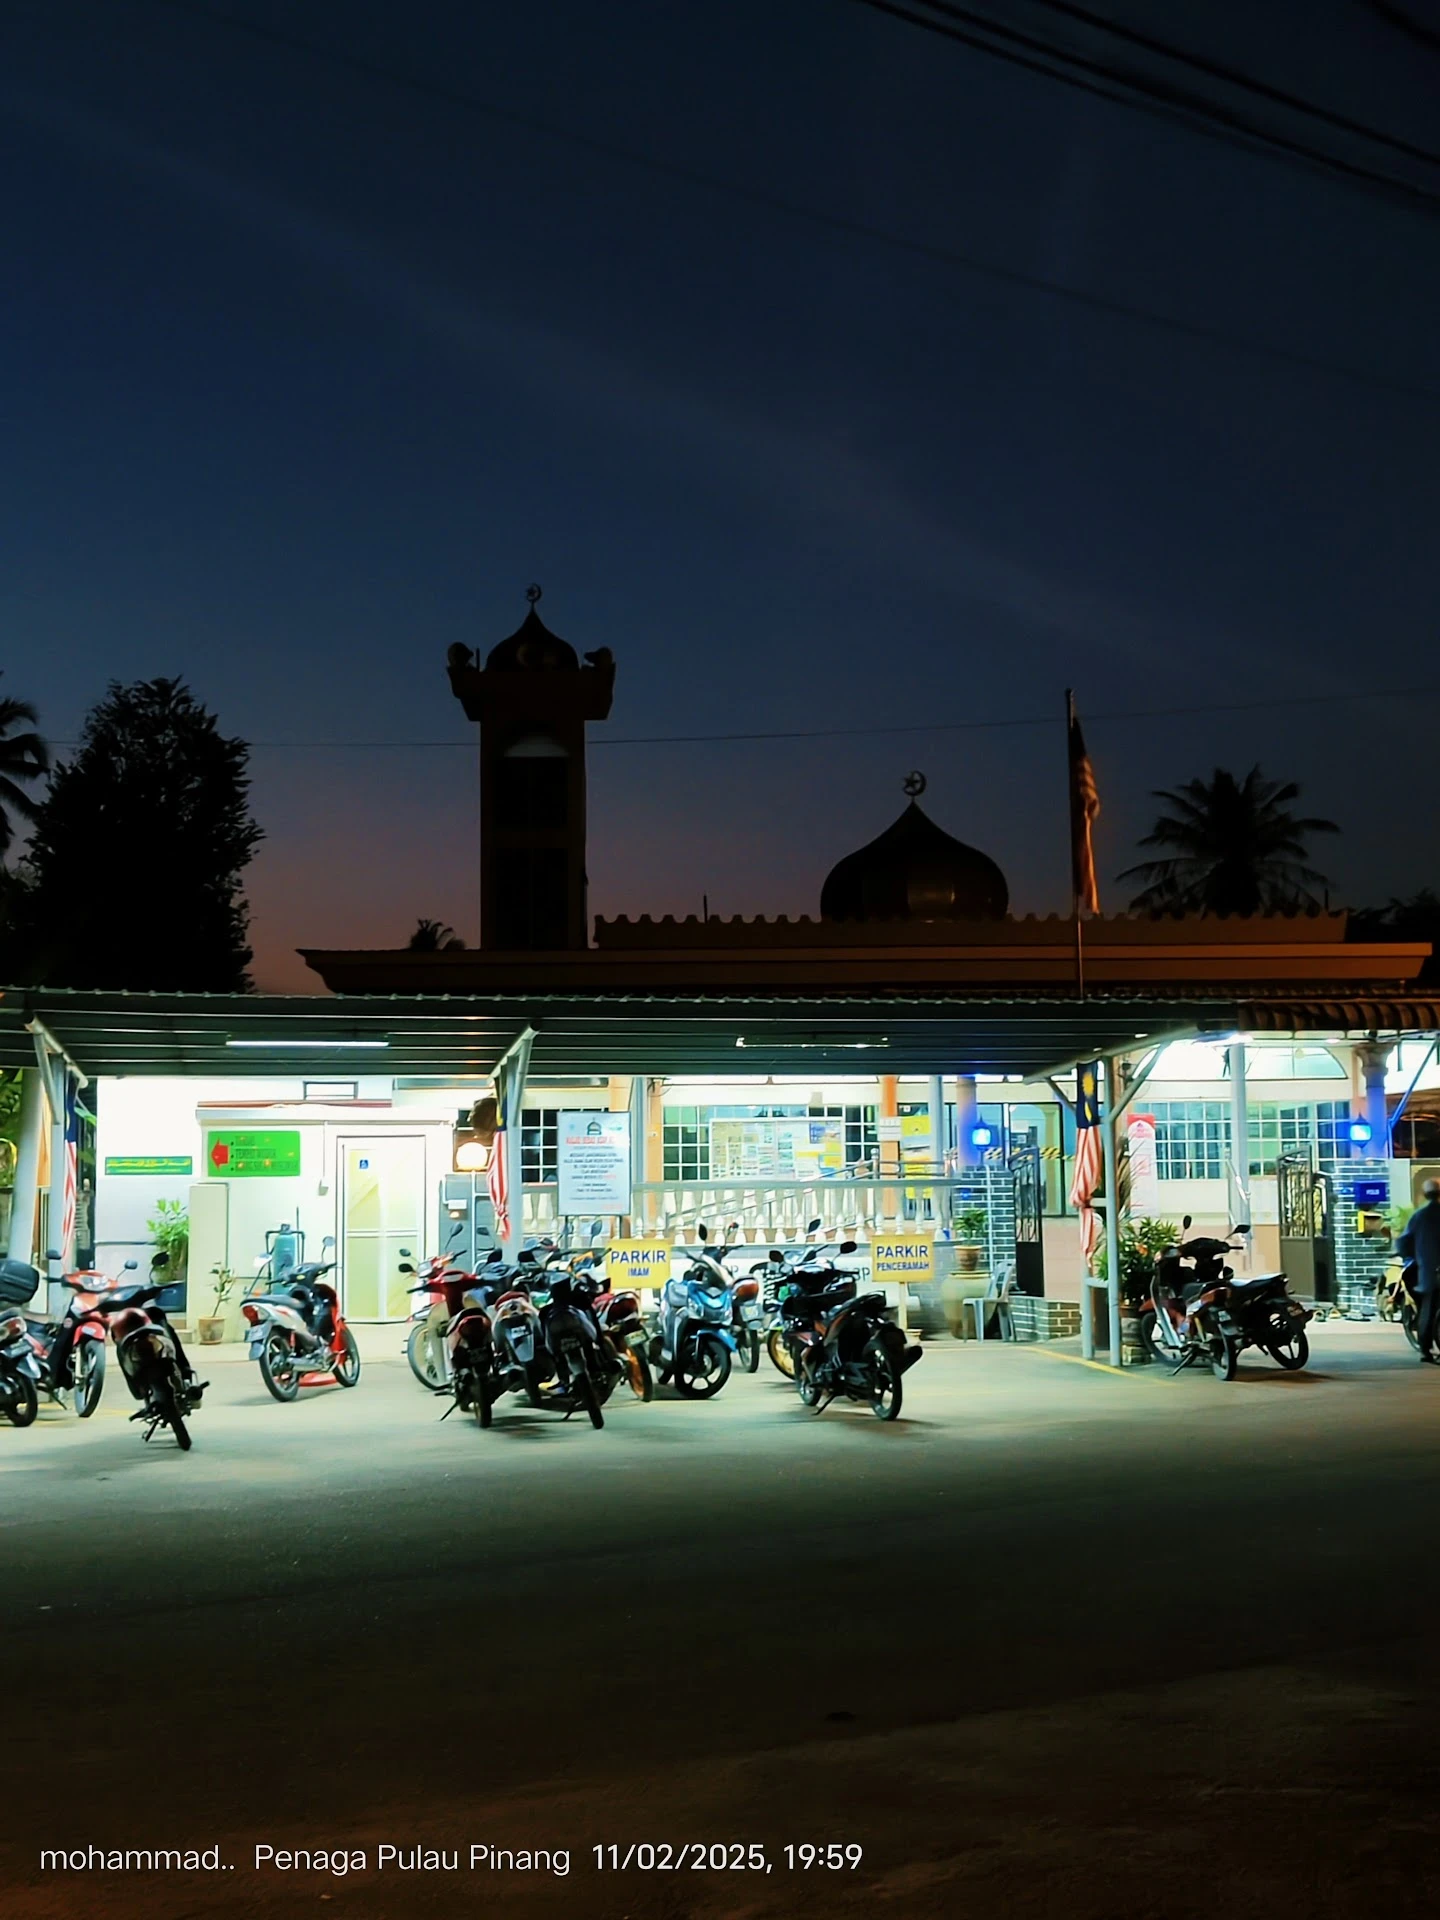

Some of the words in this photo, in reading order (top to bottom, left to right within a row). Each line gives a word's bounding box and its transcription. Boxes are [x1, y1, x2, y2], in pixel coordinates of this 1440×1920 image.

[611, 1250, 667, 1264] PARKIR
[876, 1245, 929, 1259] PARKIR
[628, 1267, 650, 1277] IMAM
[876, 1261, 930, 1272] PENCERAMAH
